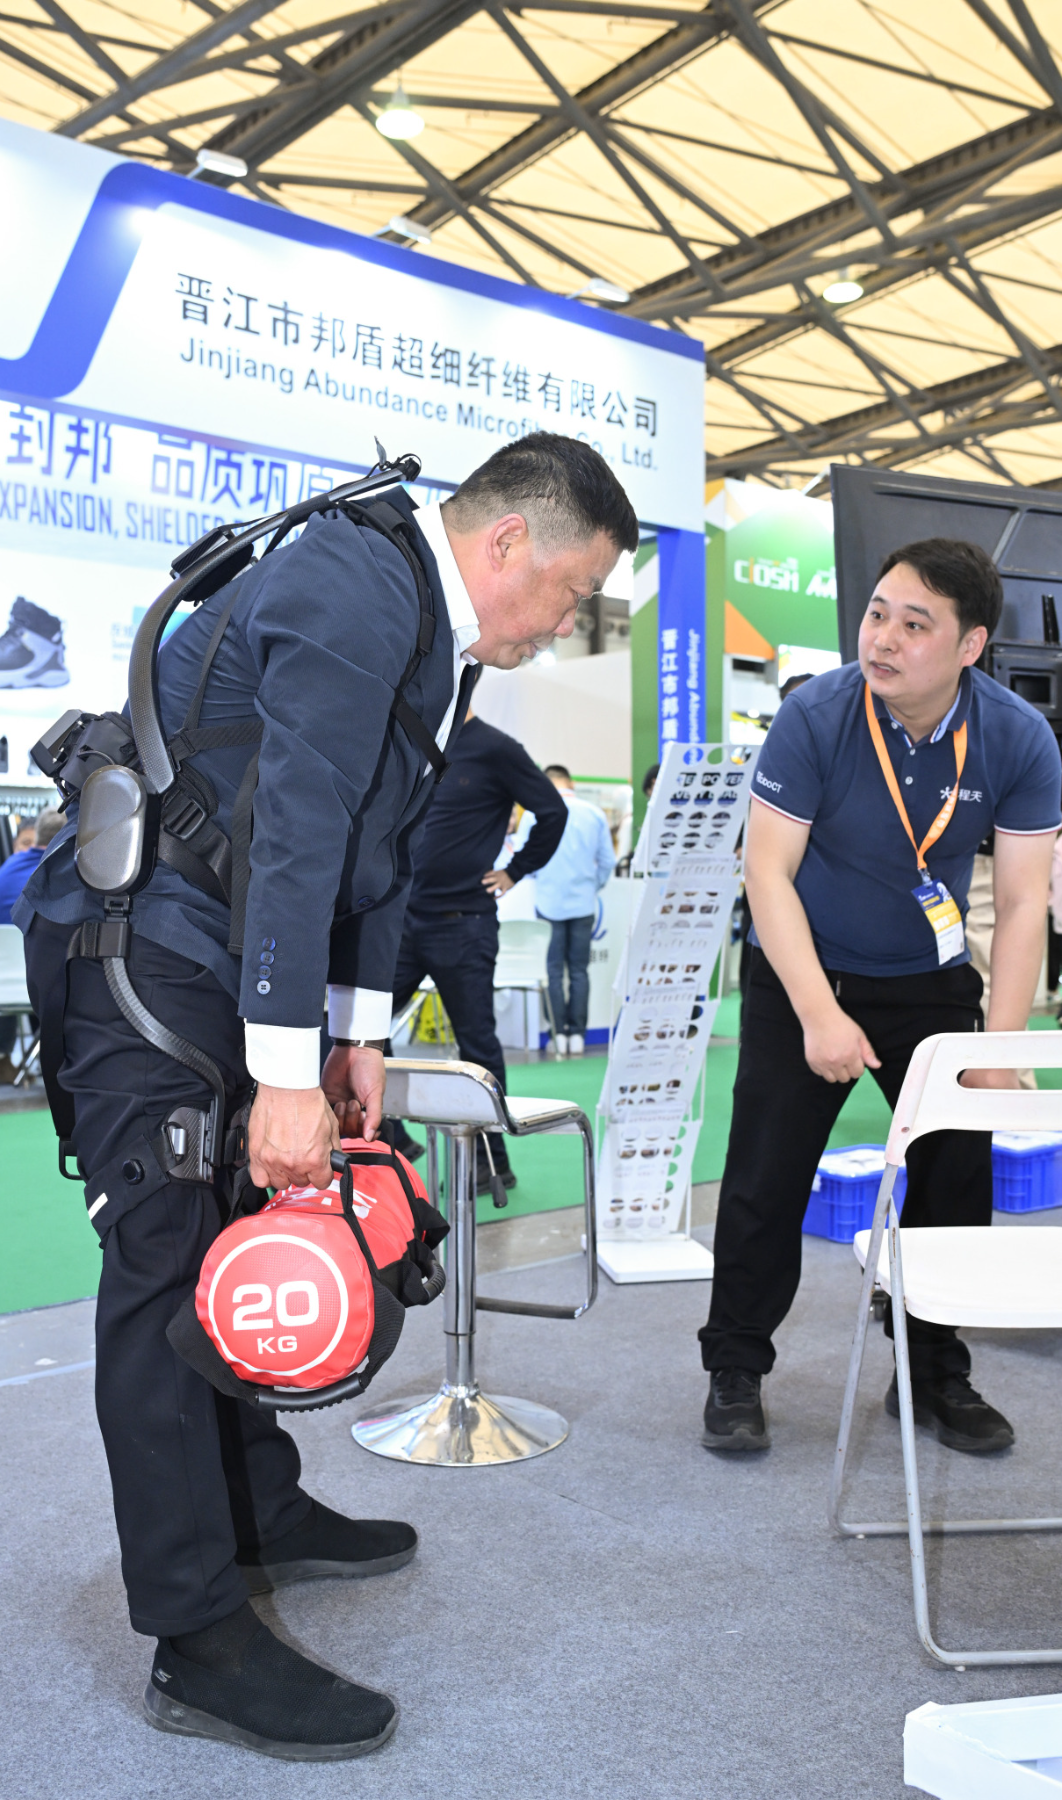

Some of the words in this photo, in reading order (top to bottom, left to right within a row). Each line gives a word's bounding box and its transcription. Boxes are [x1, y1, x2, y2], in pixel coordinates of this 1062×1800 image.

[175, 273, 658, 437] 晋江市邦盾超细纤维有限公司
[180, 338, 294, 394] Jinjiang
[303, 368, 448, 422] Abundance
[621, 442, 659, 471] Ltd.
[958, 788, 983, 803] 程天
[232, 1280, 320, 1331] 20
[257, 1335, 298, 1354] KG
